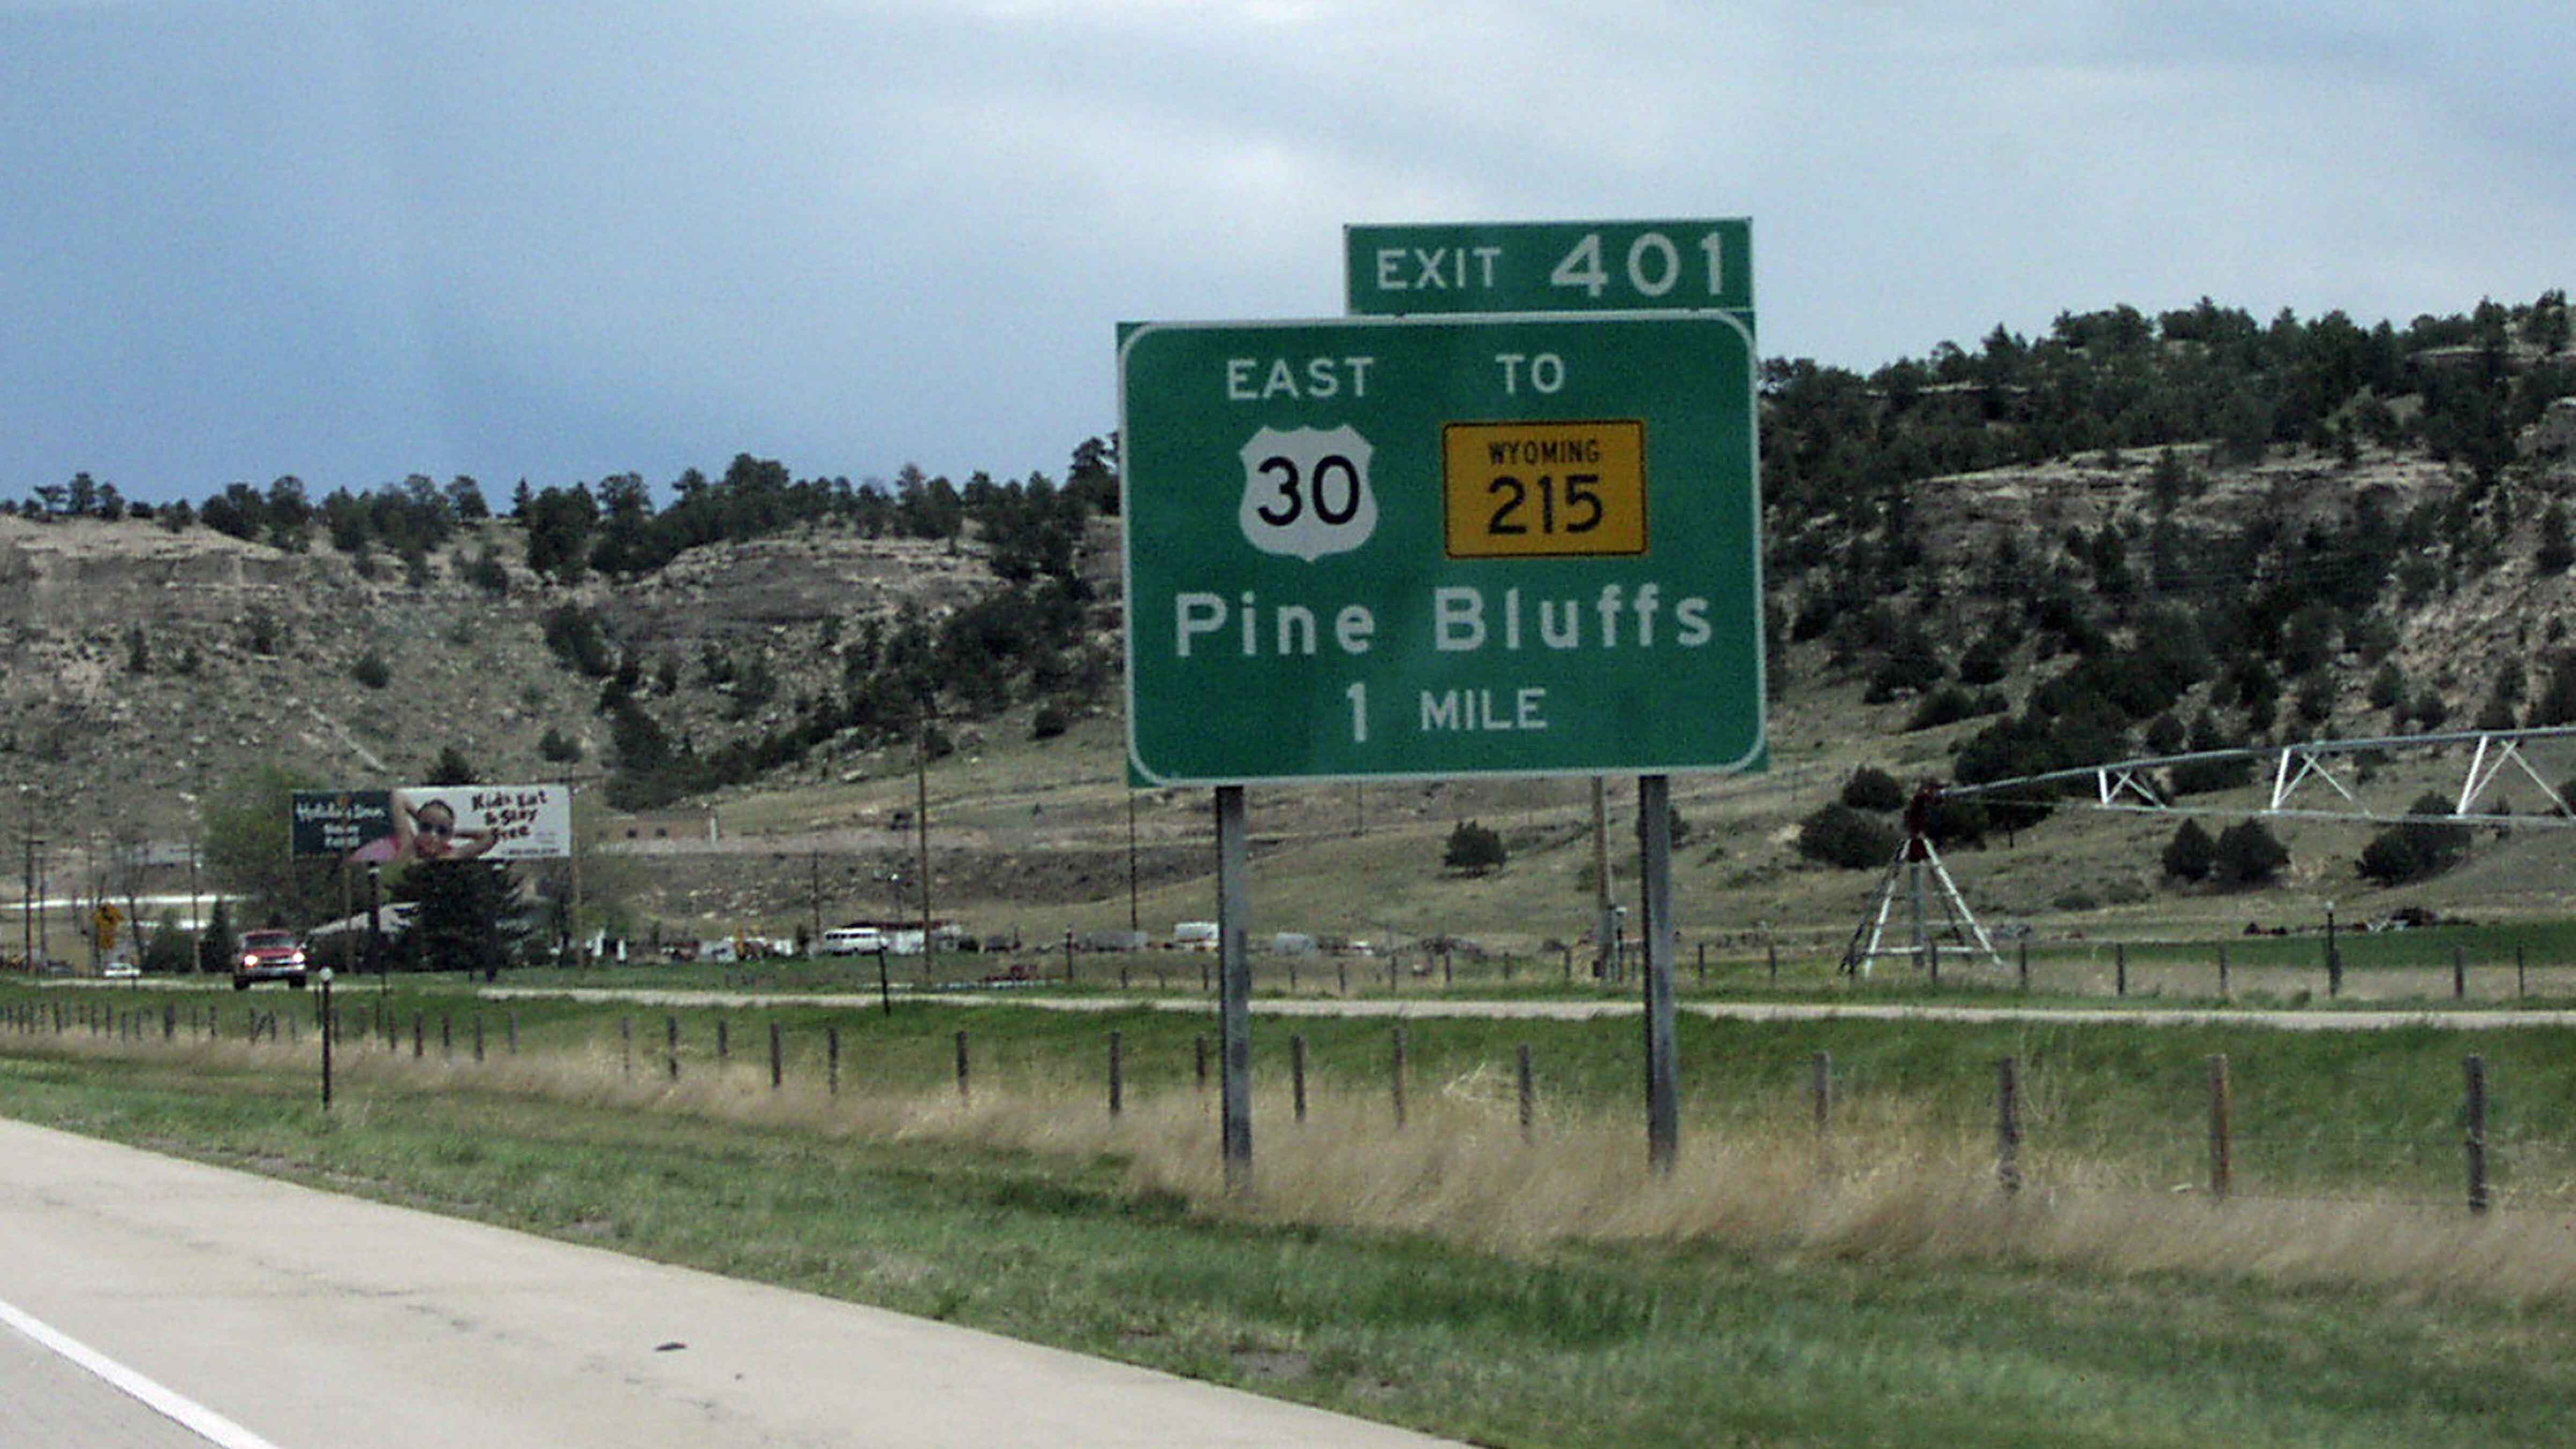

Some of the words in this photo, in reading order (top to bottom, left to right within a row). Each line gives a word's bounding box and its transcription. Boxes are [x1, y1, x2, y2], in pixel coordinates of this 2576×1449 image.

[1378, 247, 1502, 289] EXIT
[1551, 232, 1723, 297] 401
[1228, 357, 1374, 400] EAST
[1496, 354, 1564, 394] TO
[1489, 439, 1600, 464] WYOMING
[1257, 455, 1359, 526] 30
[1488, 474, 1602, 535] 215
[1176, 592, 1374, 656] Pine
[1435, 583, 1711, 651] Bluffs
[1347, 682, 1367, 742] 1
[1421, 688, 1547, 730] MILE
